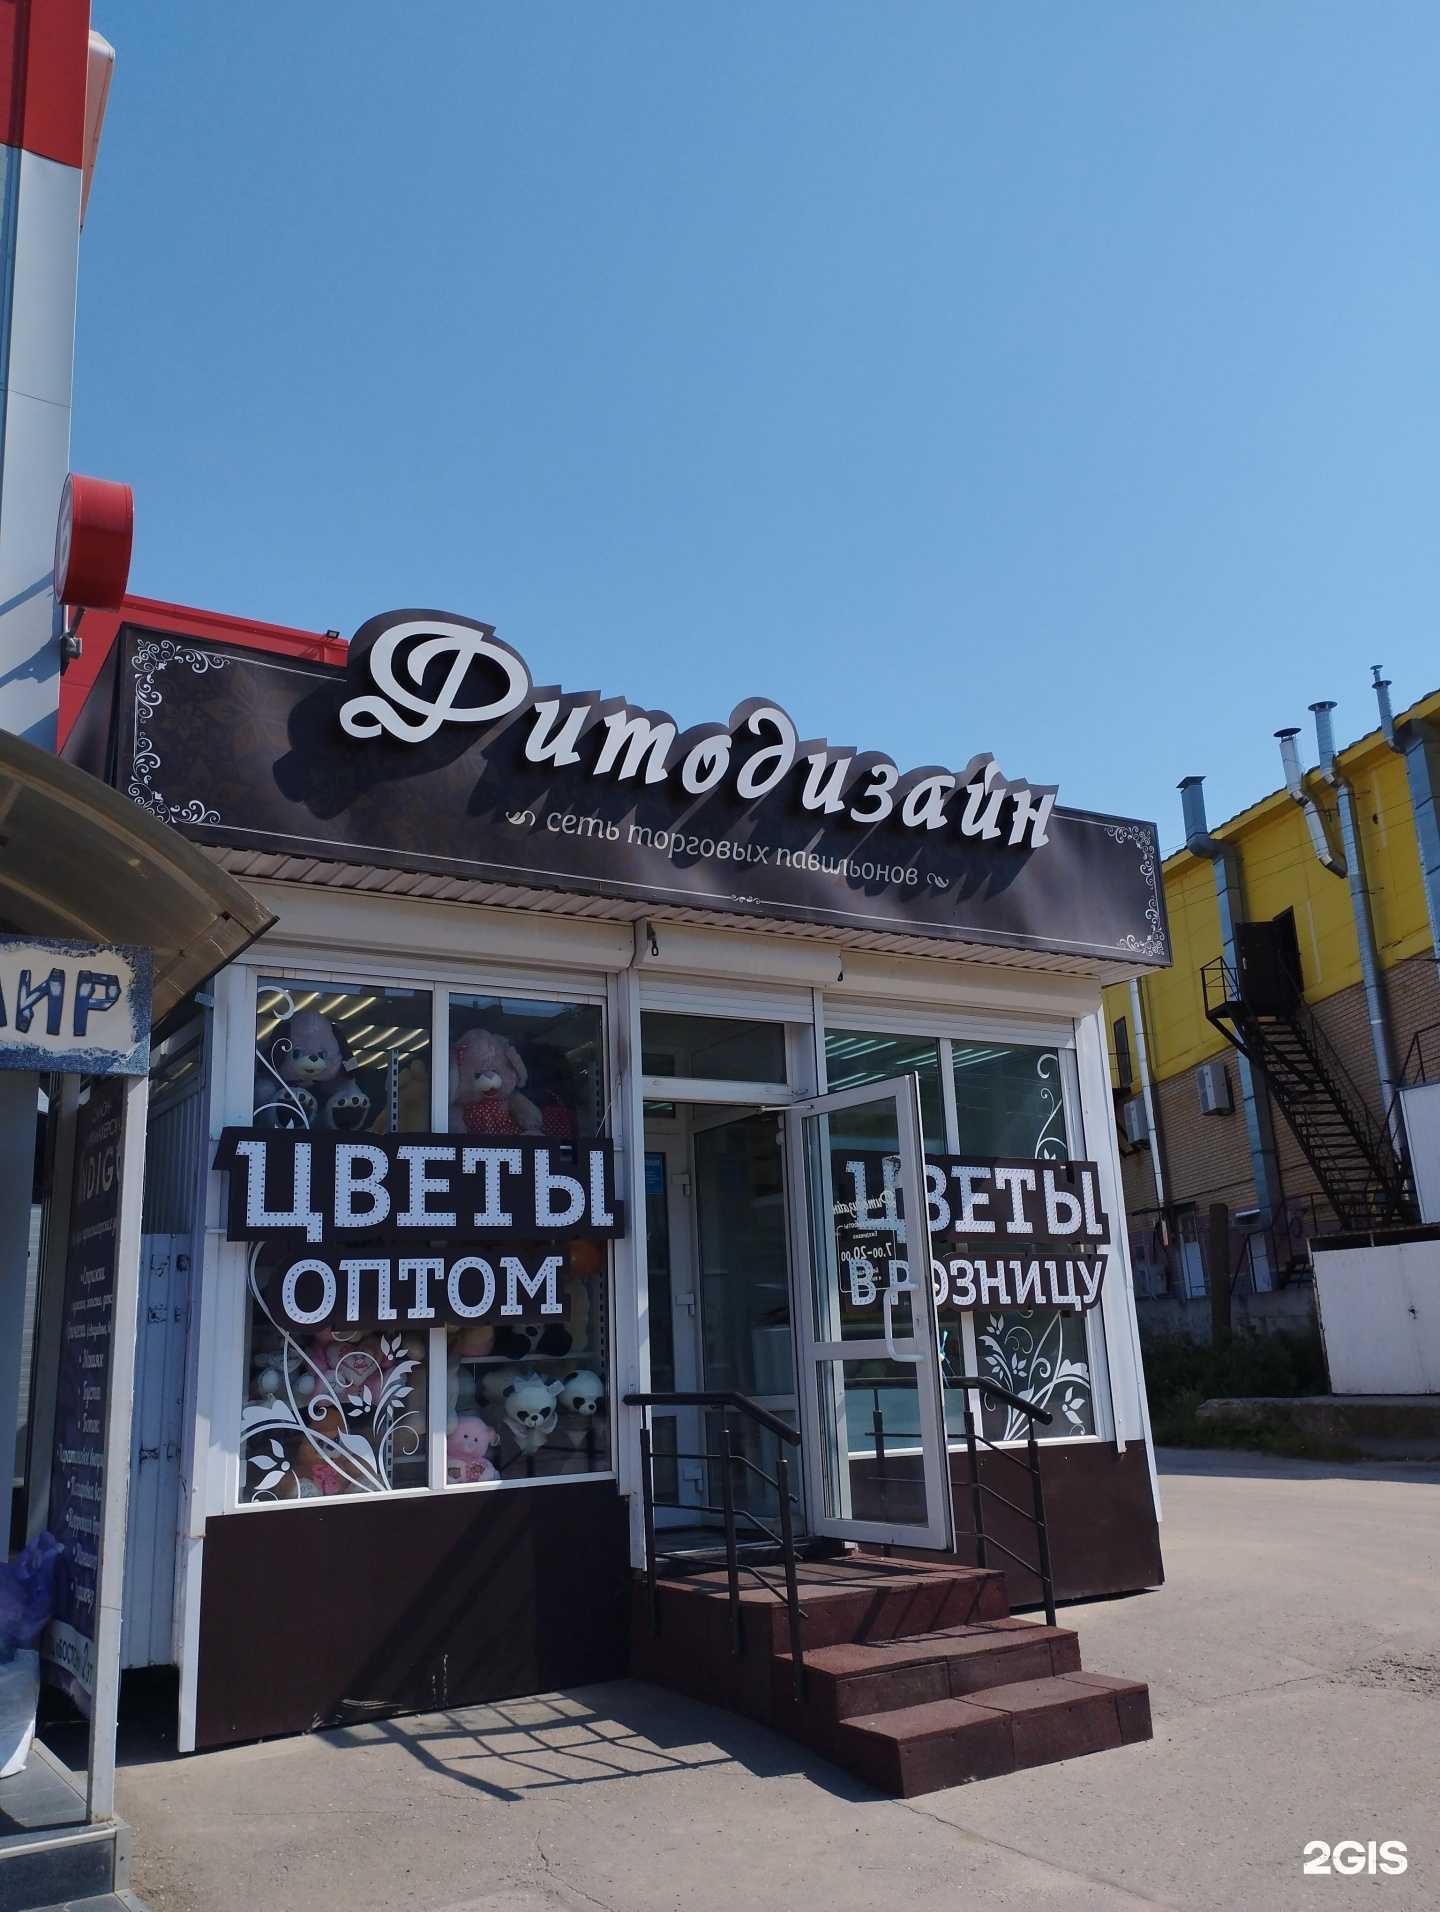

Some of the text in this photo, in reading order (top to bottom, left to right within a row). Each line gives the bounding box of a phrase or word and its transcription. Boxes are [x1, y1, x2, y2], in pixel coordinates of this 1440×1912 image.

[340, 621, 1059, 849] Фитодизайн
[546, 811, 919, 886] сеть торговых павильонов
[0, 967, 122, 1037] ИР
[235, 1140, 614, 1243] ЦВЕТЫ
[846, 1160, 1104, 1243] ЦВЕТЫ
[282, 1256, 563, 1325] ОПТОМ
[848, 1260, 877, 1306] В
